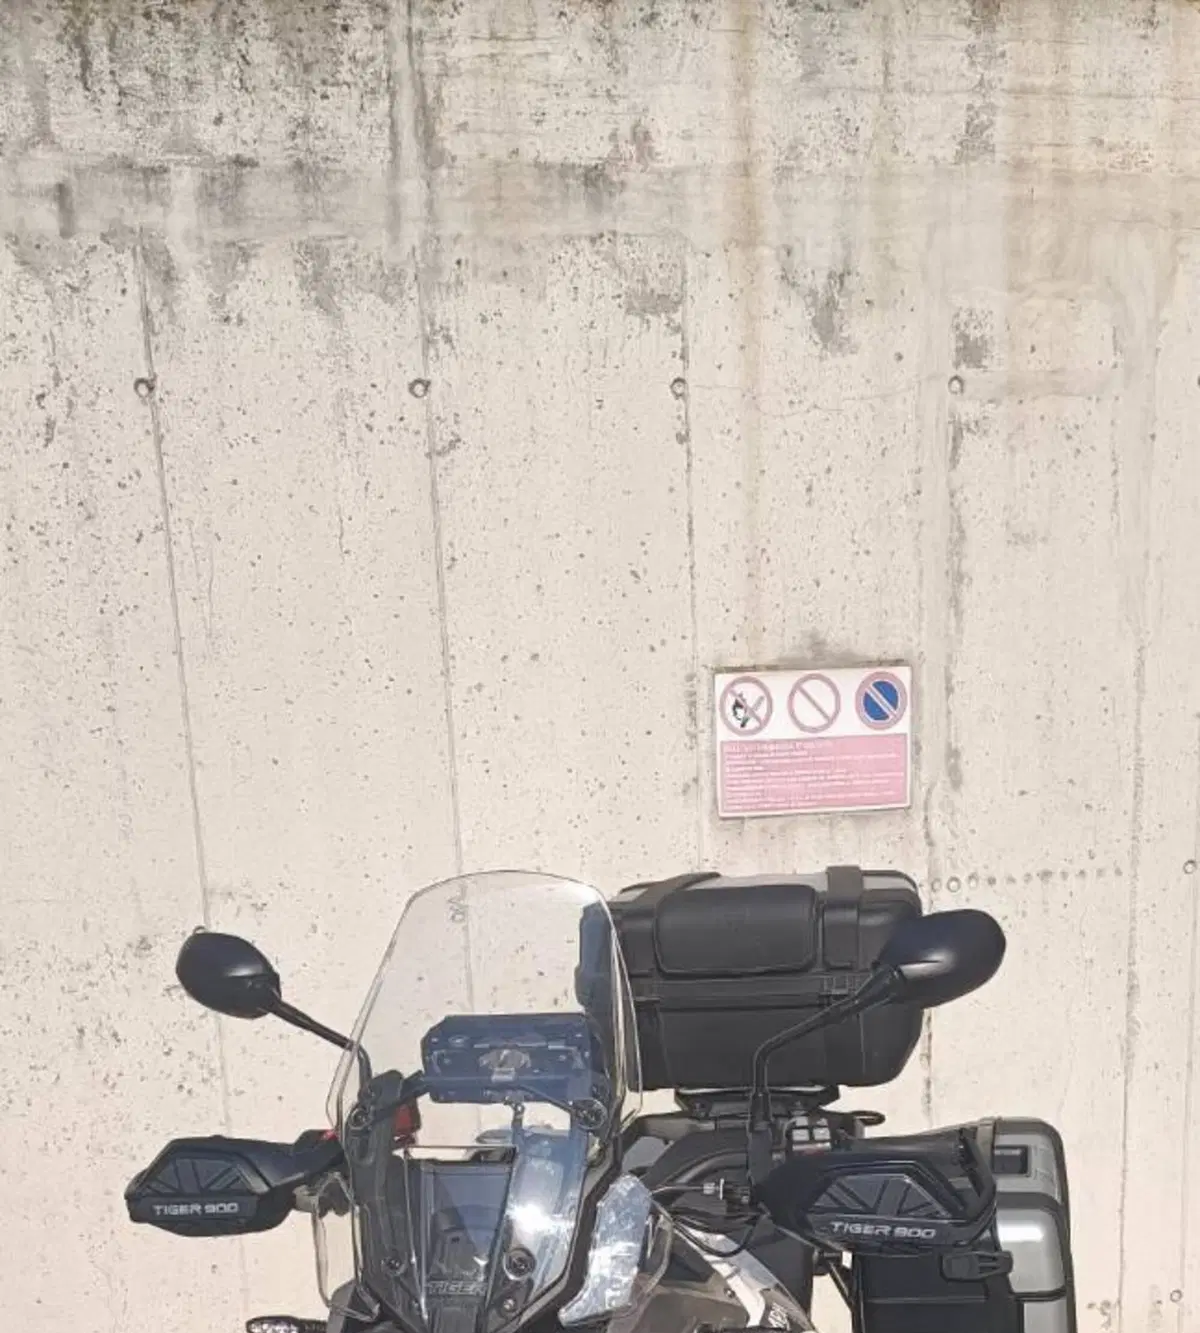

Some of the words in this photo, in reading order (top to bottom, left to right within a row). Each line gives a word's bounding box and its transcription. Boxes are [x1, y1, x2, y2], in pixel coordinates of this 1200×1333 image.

[153, 1203, 201, 1215] TIGER
[204, 1202, 239, 1214] 900
[830, 1221, 892, 1236] TIGER
[426, 1281, 487, 1296] TIGER
